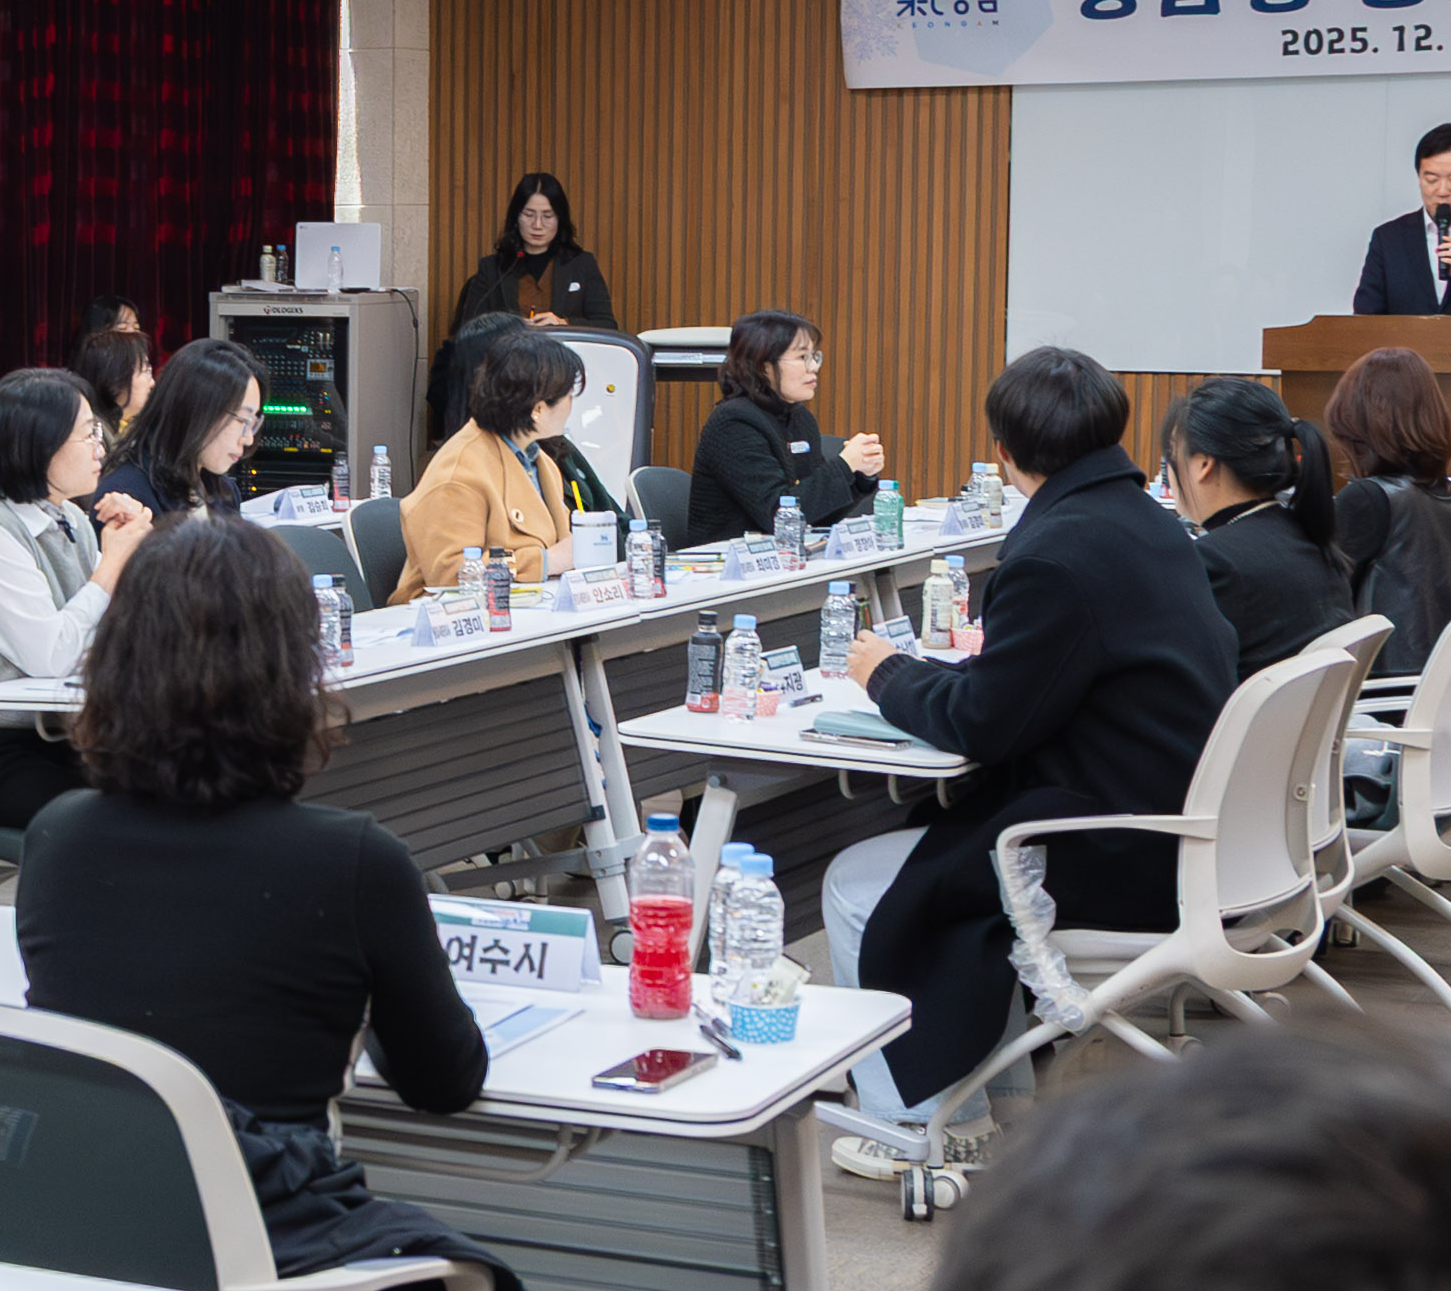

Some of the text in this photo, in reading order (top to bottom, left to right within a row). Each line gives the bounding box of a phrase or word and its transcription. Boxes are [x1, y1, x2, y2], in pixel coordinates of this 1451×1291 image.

[1281, 26, 1379, 58] 2025.
[1392, 24, 1443, 52] 12.
[593, 584, 624, 603] 안소리
[452, 615, 485, 637] 김경미
[446, 934, 548, 980] 여수시
